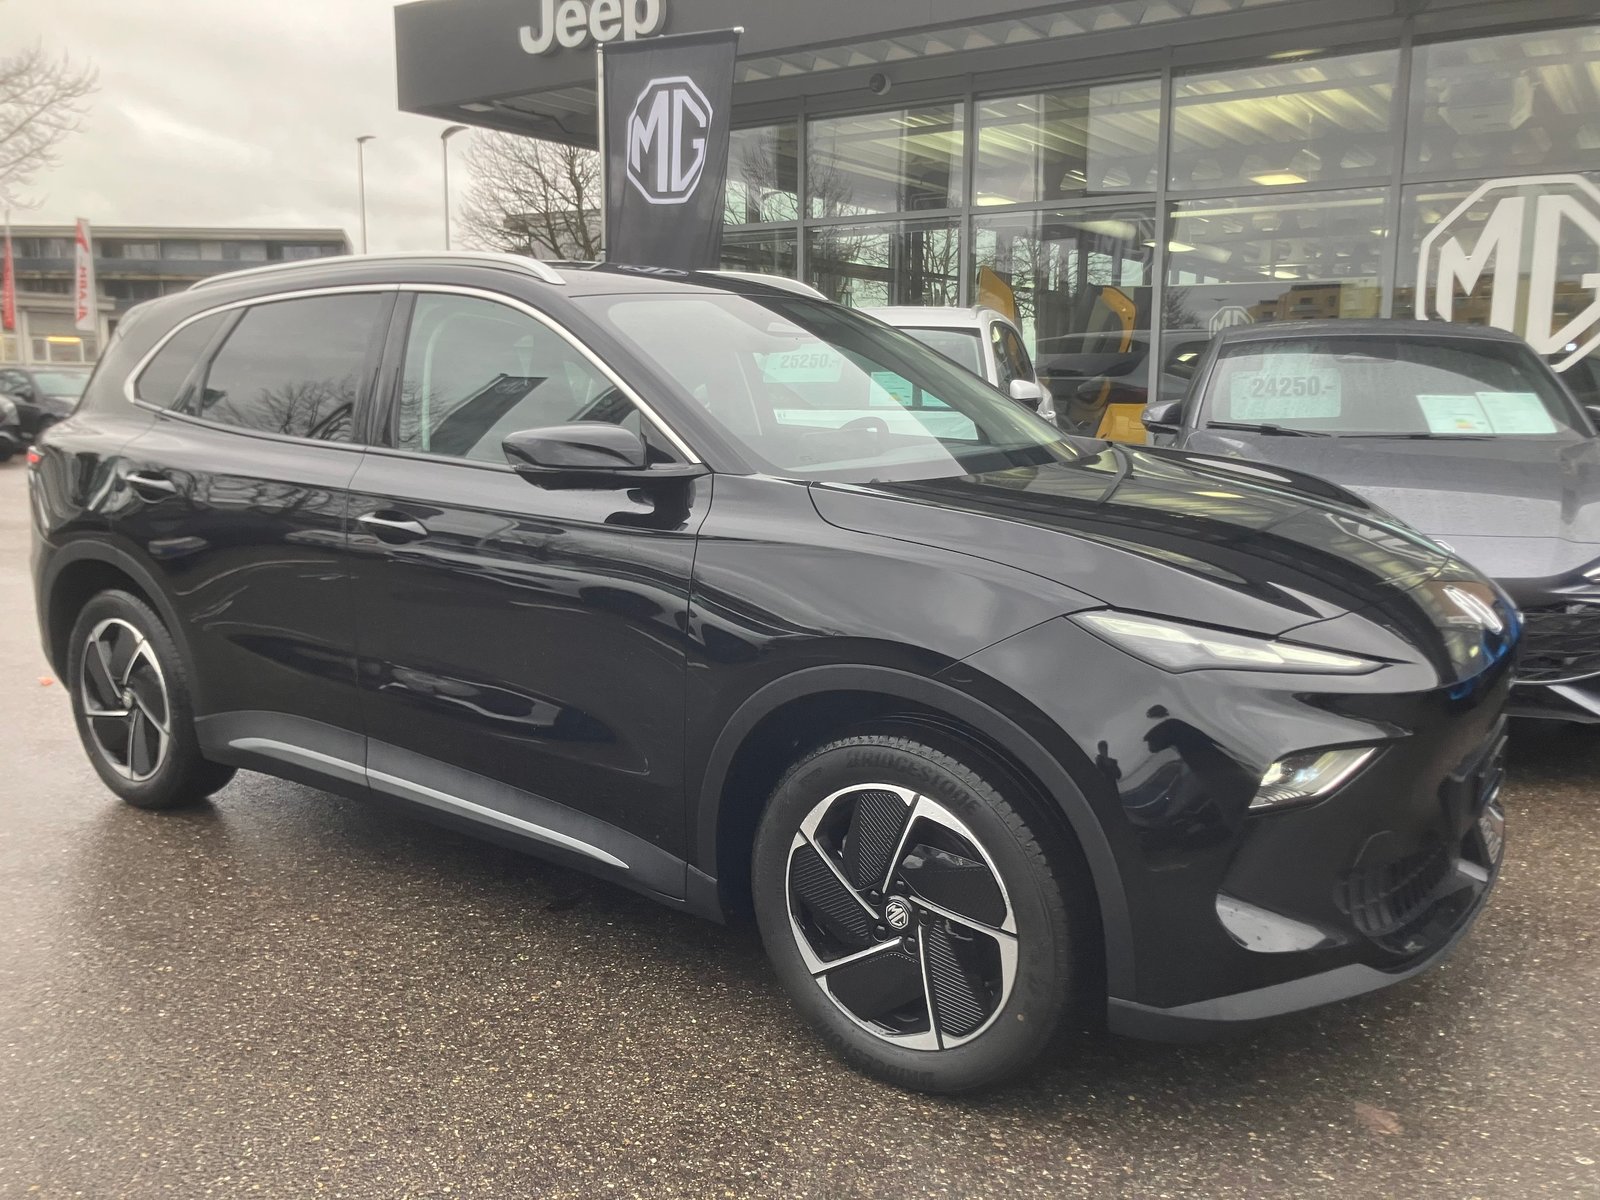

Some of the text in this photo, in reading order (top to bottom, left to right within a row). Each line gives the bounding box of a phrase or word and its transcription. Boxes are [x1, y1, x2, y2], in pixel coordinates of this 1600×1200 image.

[519, 0, 662, 54] Jeep
[630, 87, 708, 194] MG
[1436, 194, 1600, 355] MG
[1251, 375, 1337, 398] 24250.-
[887, 903, 907, 928] MG
